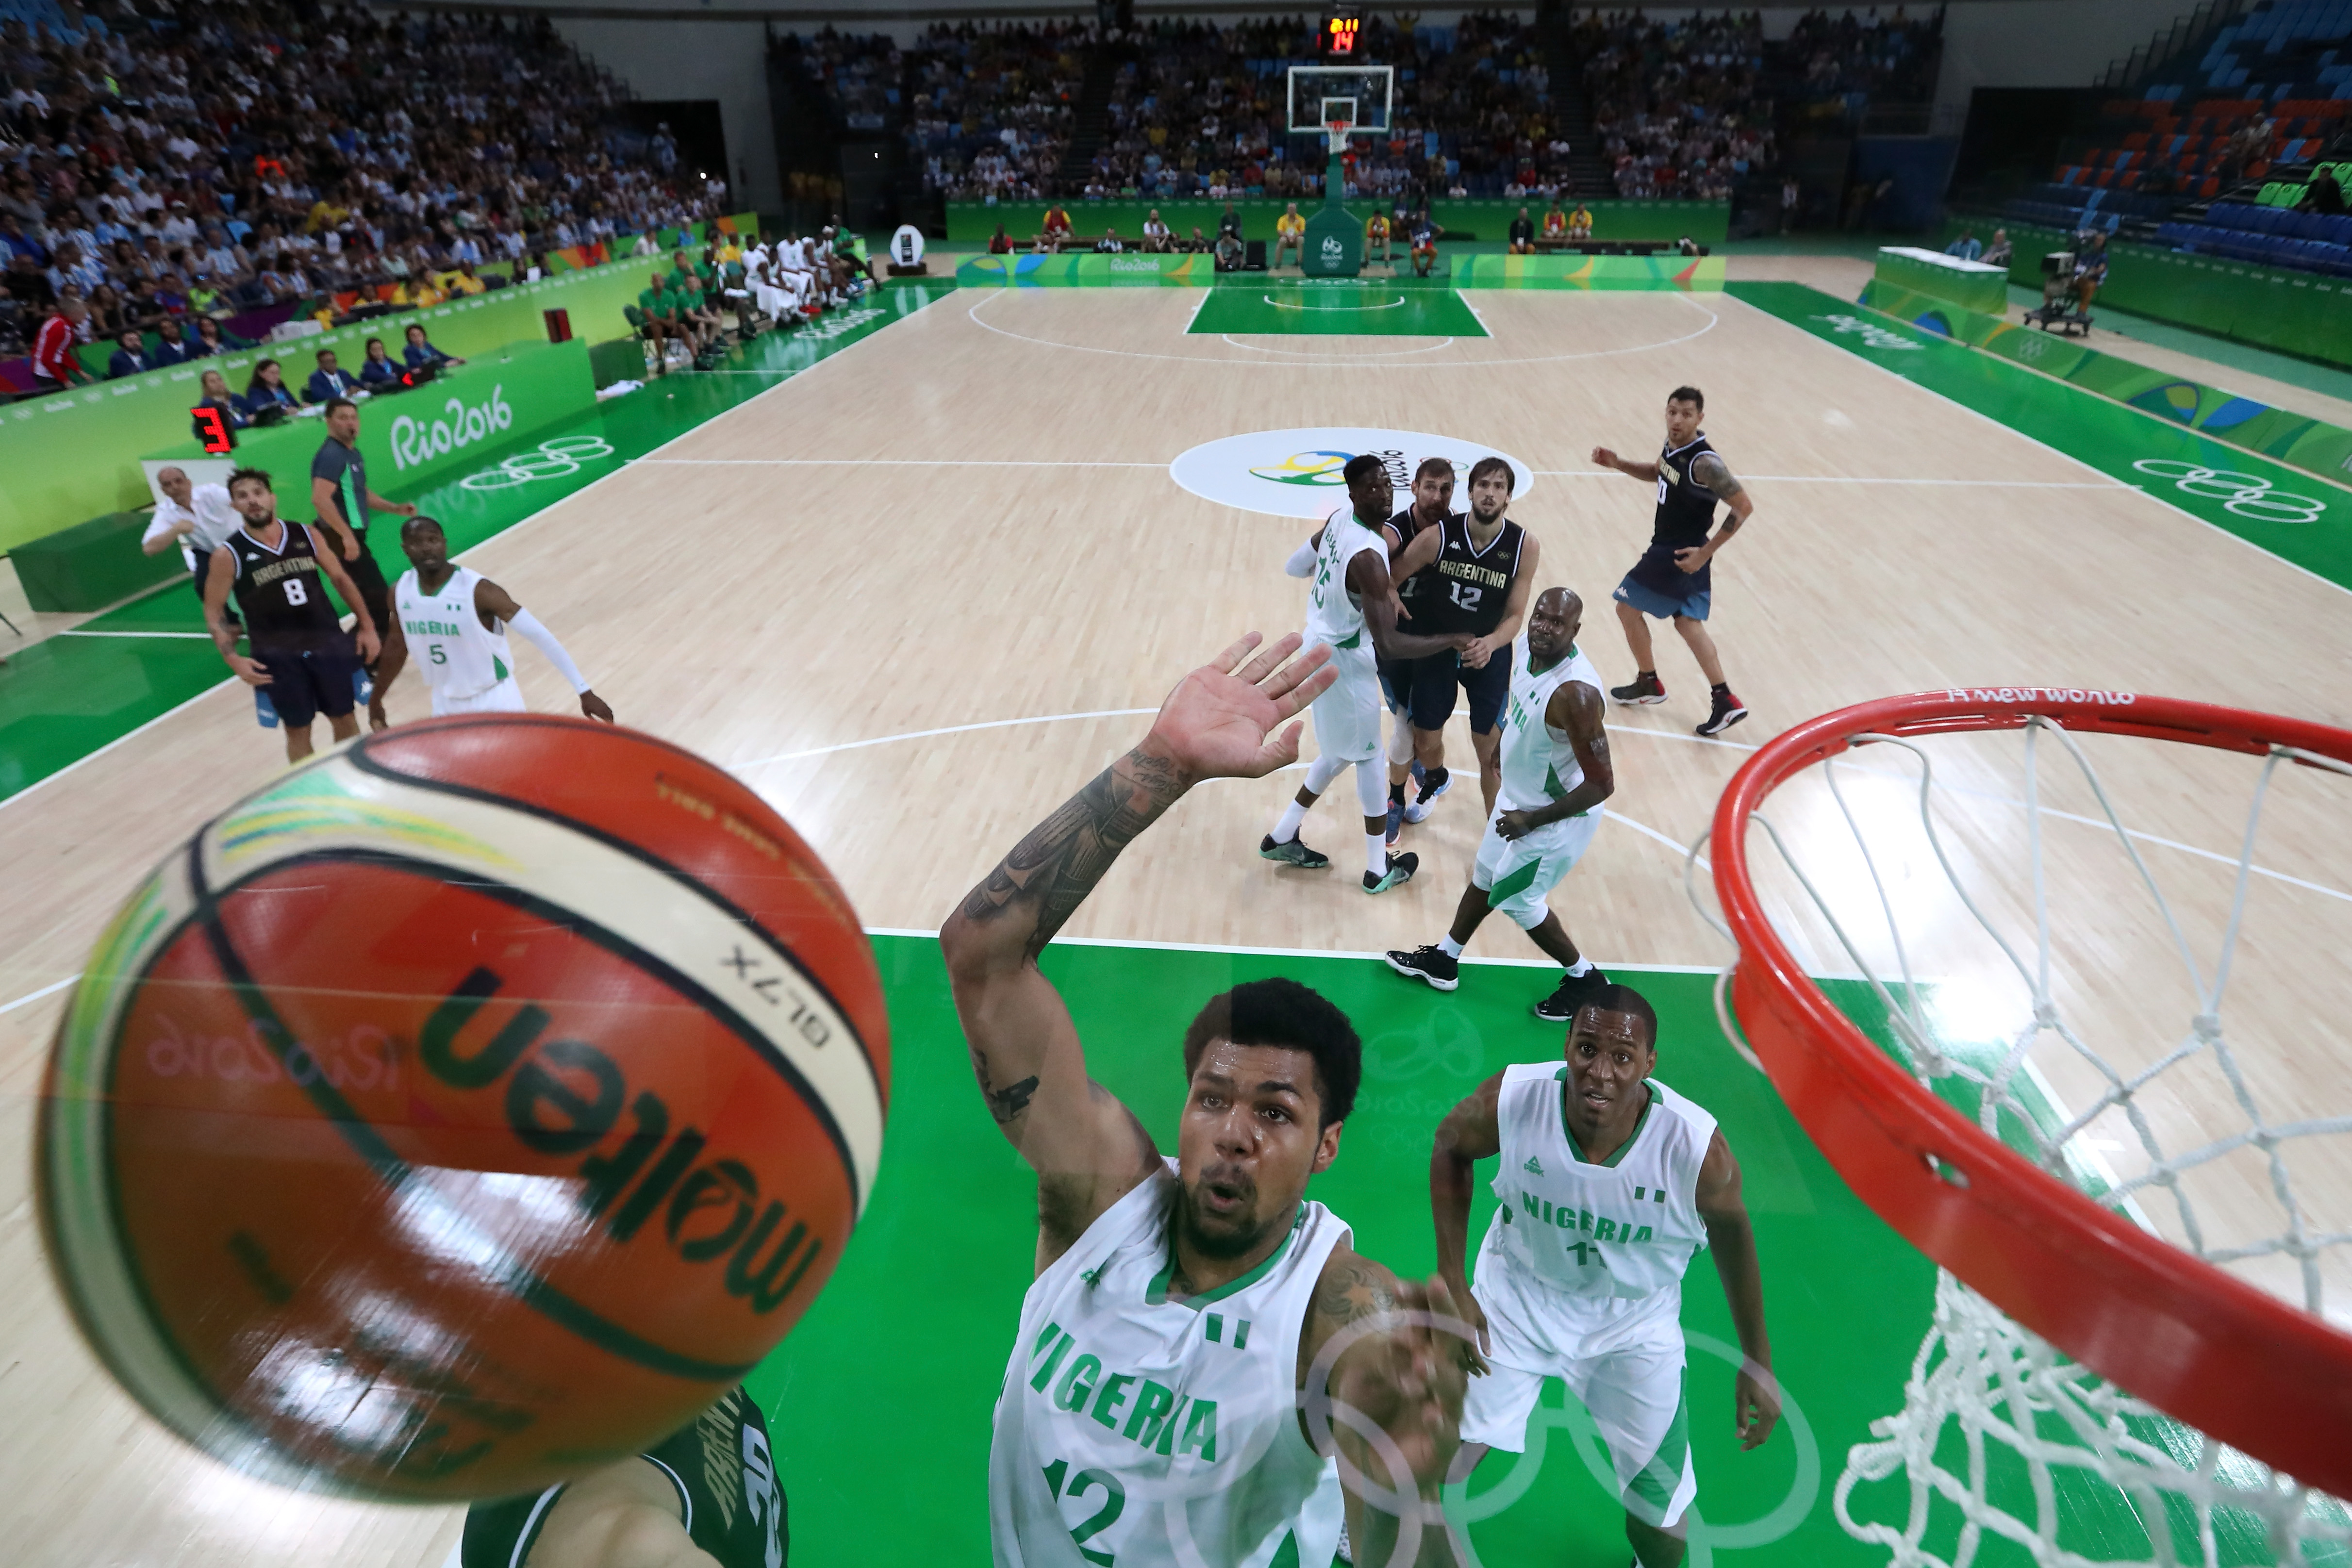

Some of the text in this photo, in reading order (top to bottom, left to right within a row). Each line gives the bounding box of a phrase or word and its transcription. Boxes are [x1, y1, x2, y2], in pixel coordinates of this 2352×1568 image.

[1333, 32, 1354, 50] 14
[1110, 258, 1159, 271] Rio2016
[190, 407, 232, 453] 3
[390, 383, 512, 471] Rio2016
[251, 556, 316, 587] ARGENTINA
[1439, 560, 1507, 589] ARGENTINA
[282, 578, 309, 606] 8
[1449, 580, 1482, 613] 12
[405, 620, 461, 636] NIGERIA
[429, 644, 447, 664] 5
[1947, 689, 1971, 703] A
[1973, 688, 2037, 704] new
[718, 944, 831, 1051] GL7X
[419, 965, 824, 1315] molten
[1522, 1190, 1652, 1244] NIGERIA
